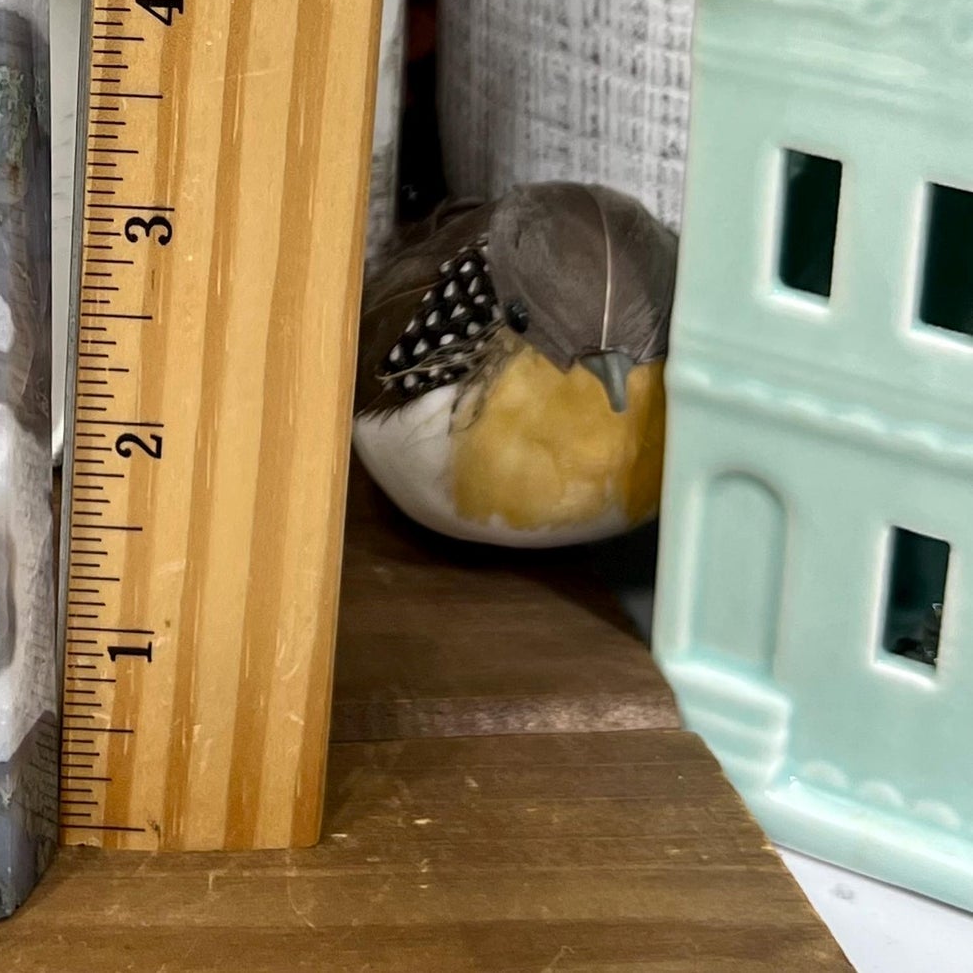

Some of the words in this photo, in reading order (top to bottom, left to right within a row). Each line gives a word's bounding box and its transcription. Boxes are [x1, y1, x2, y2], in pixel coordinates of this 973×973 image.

[124, 215, 173, 246] 3
[115, 432, 163, 460] 2
[107, 641, 153, 663] 1
